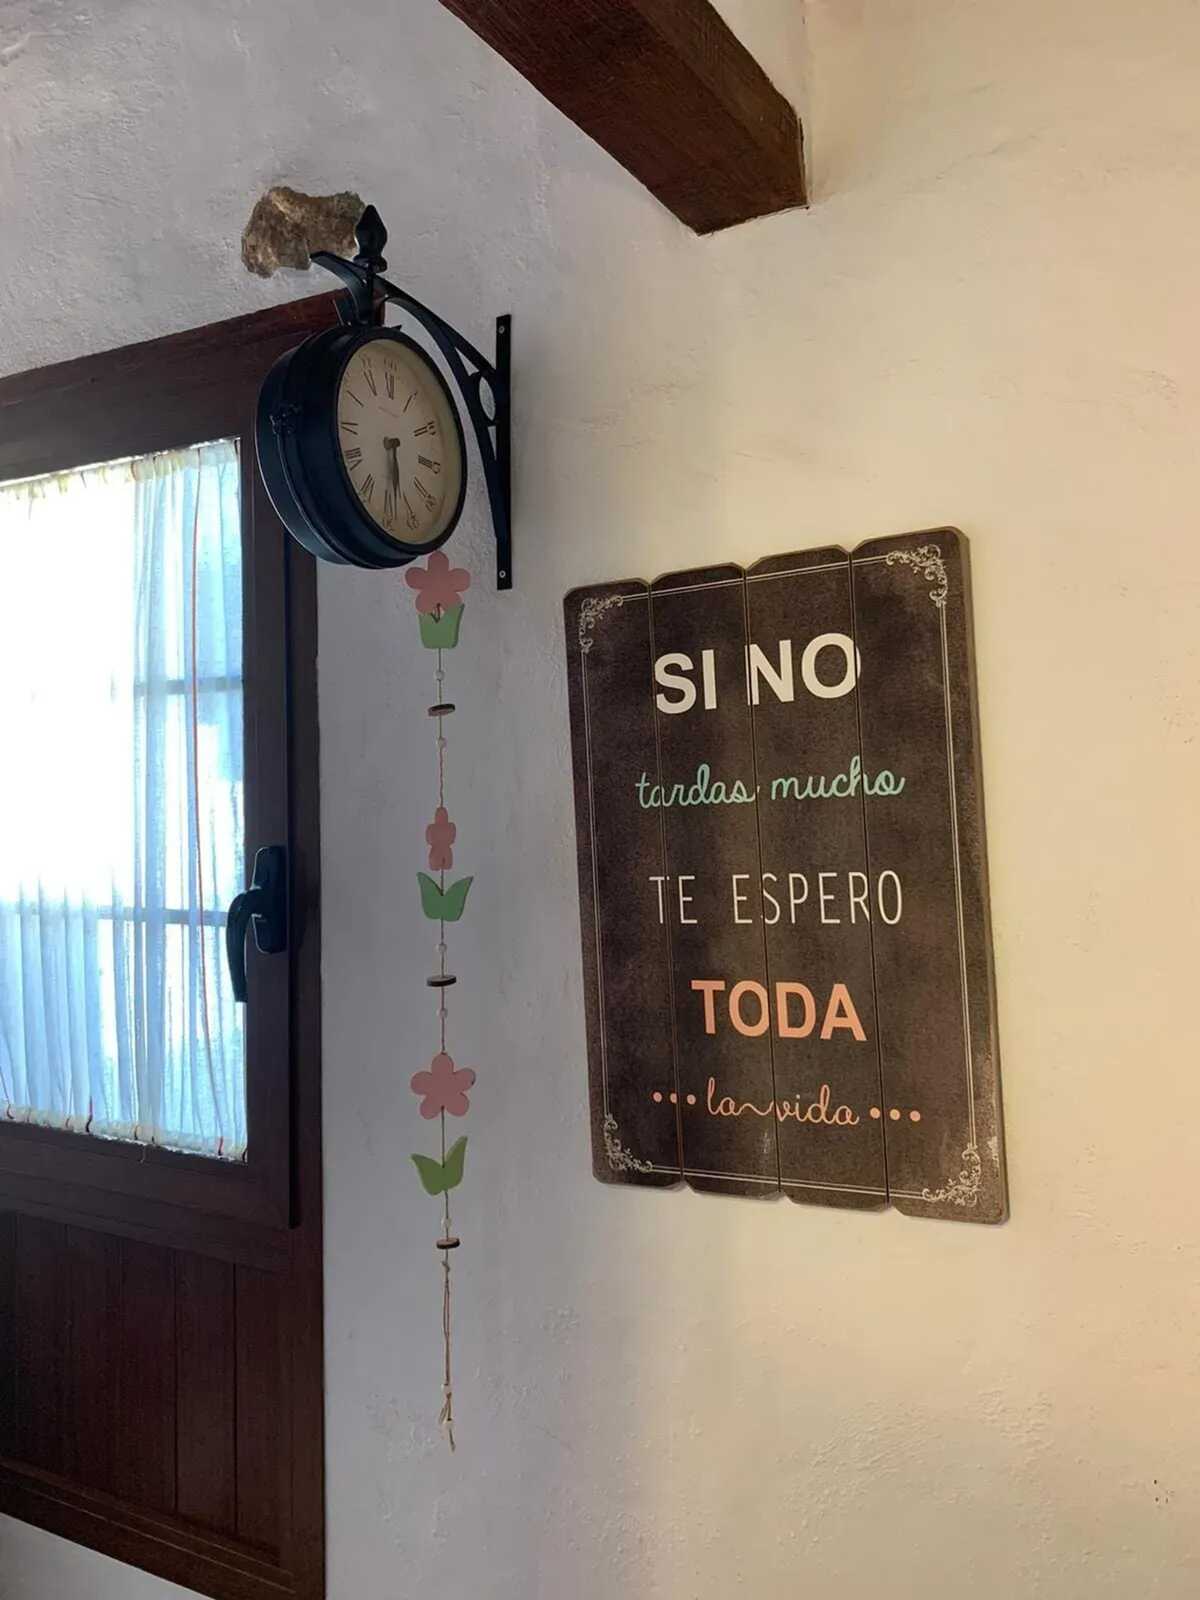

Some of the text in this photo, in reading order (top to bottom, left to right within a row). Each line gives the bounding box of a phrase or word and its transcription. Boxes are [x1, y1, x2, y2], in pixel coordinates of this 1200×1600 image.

[654, 632, 862, 714] SI NO
[635, 755, 906, 808] tardas mucho
[649, 869, 903, 925] TE ESPERO
[691, 979, 867, 1042] TODA
